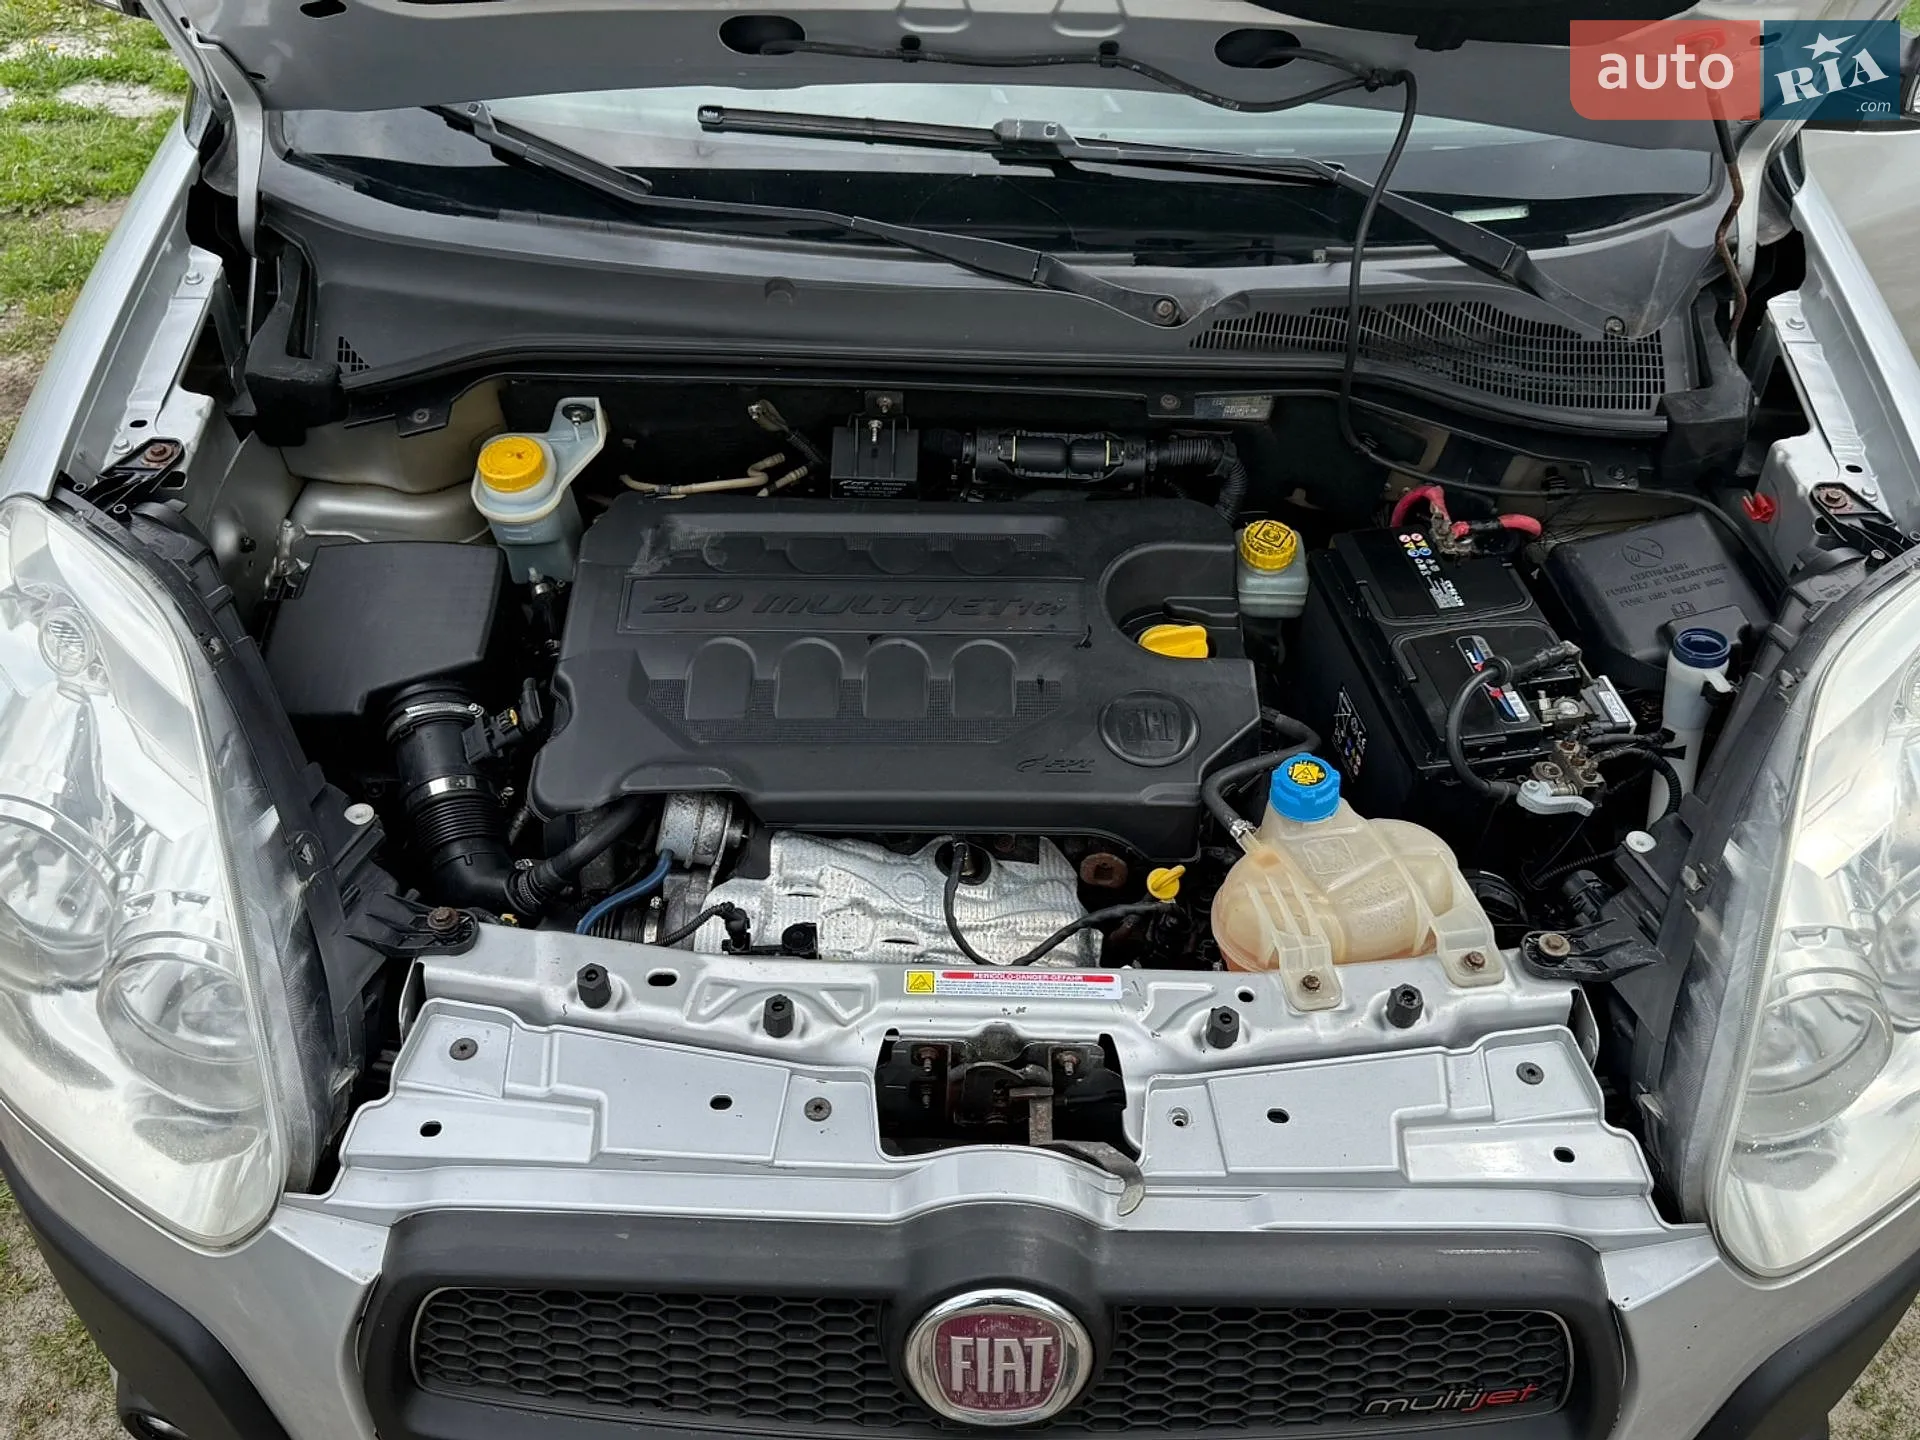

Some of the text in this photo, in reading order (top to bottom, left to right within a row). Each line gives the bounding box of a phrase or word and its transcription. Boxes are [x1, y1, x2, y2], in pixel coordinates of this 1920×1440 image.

[642, 592, 743, 614] 2.0
[950, 1335, 1053, 1393] FIAT
[1364, 1383, 1538, 1413] multijet
